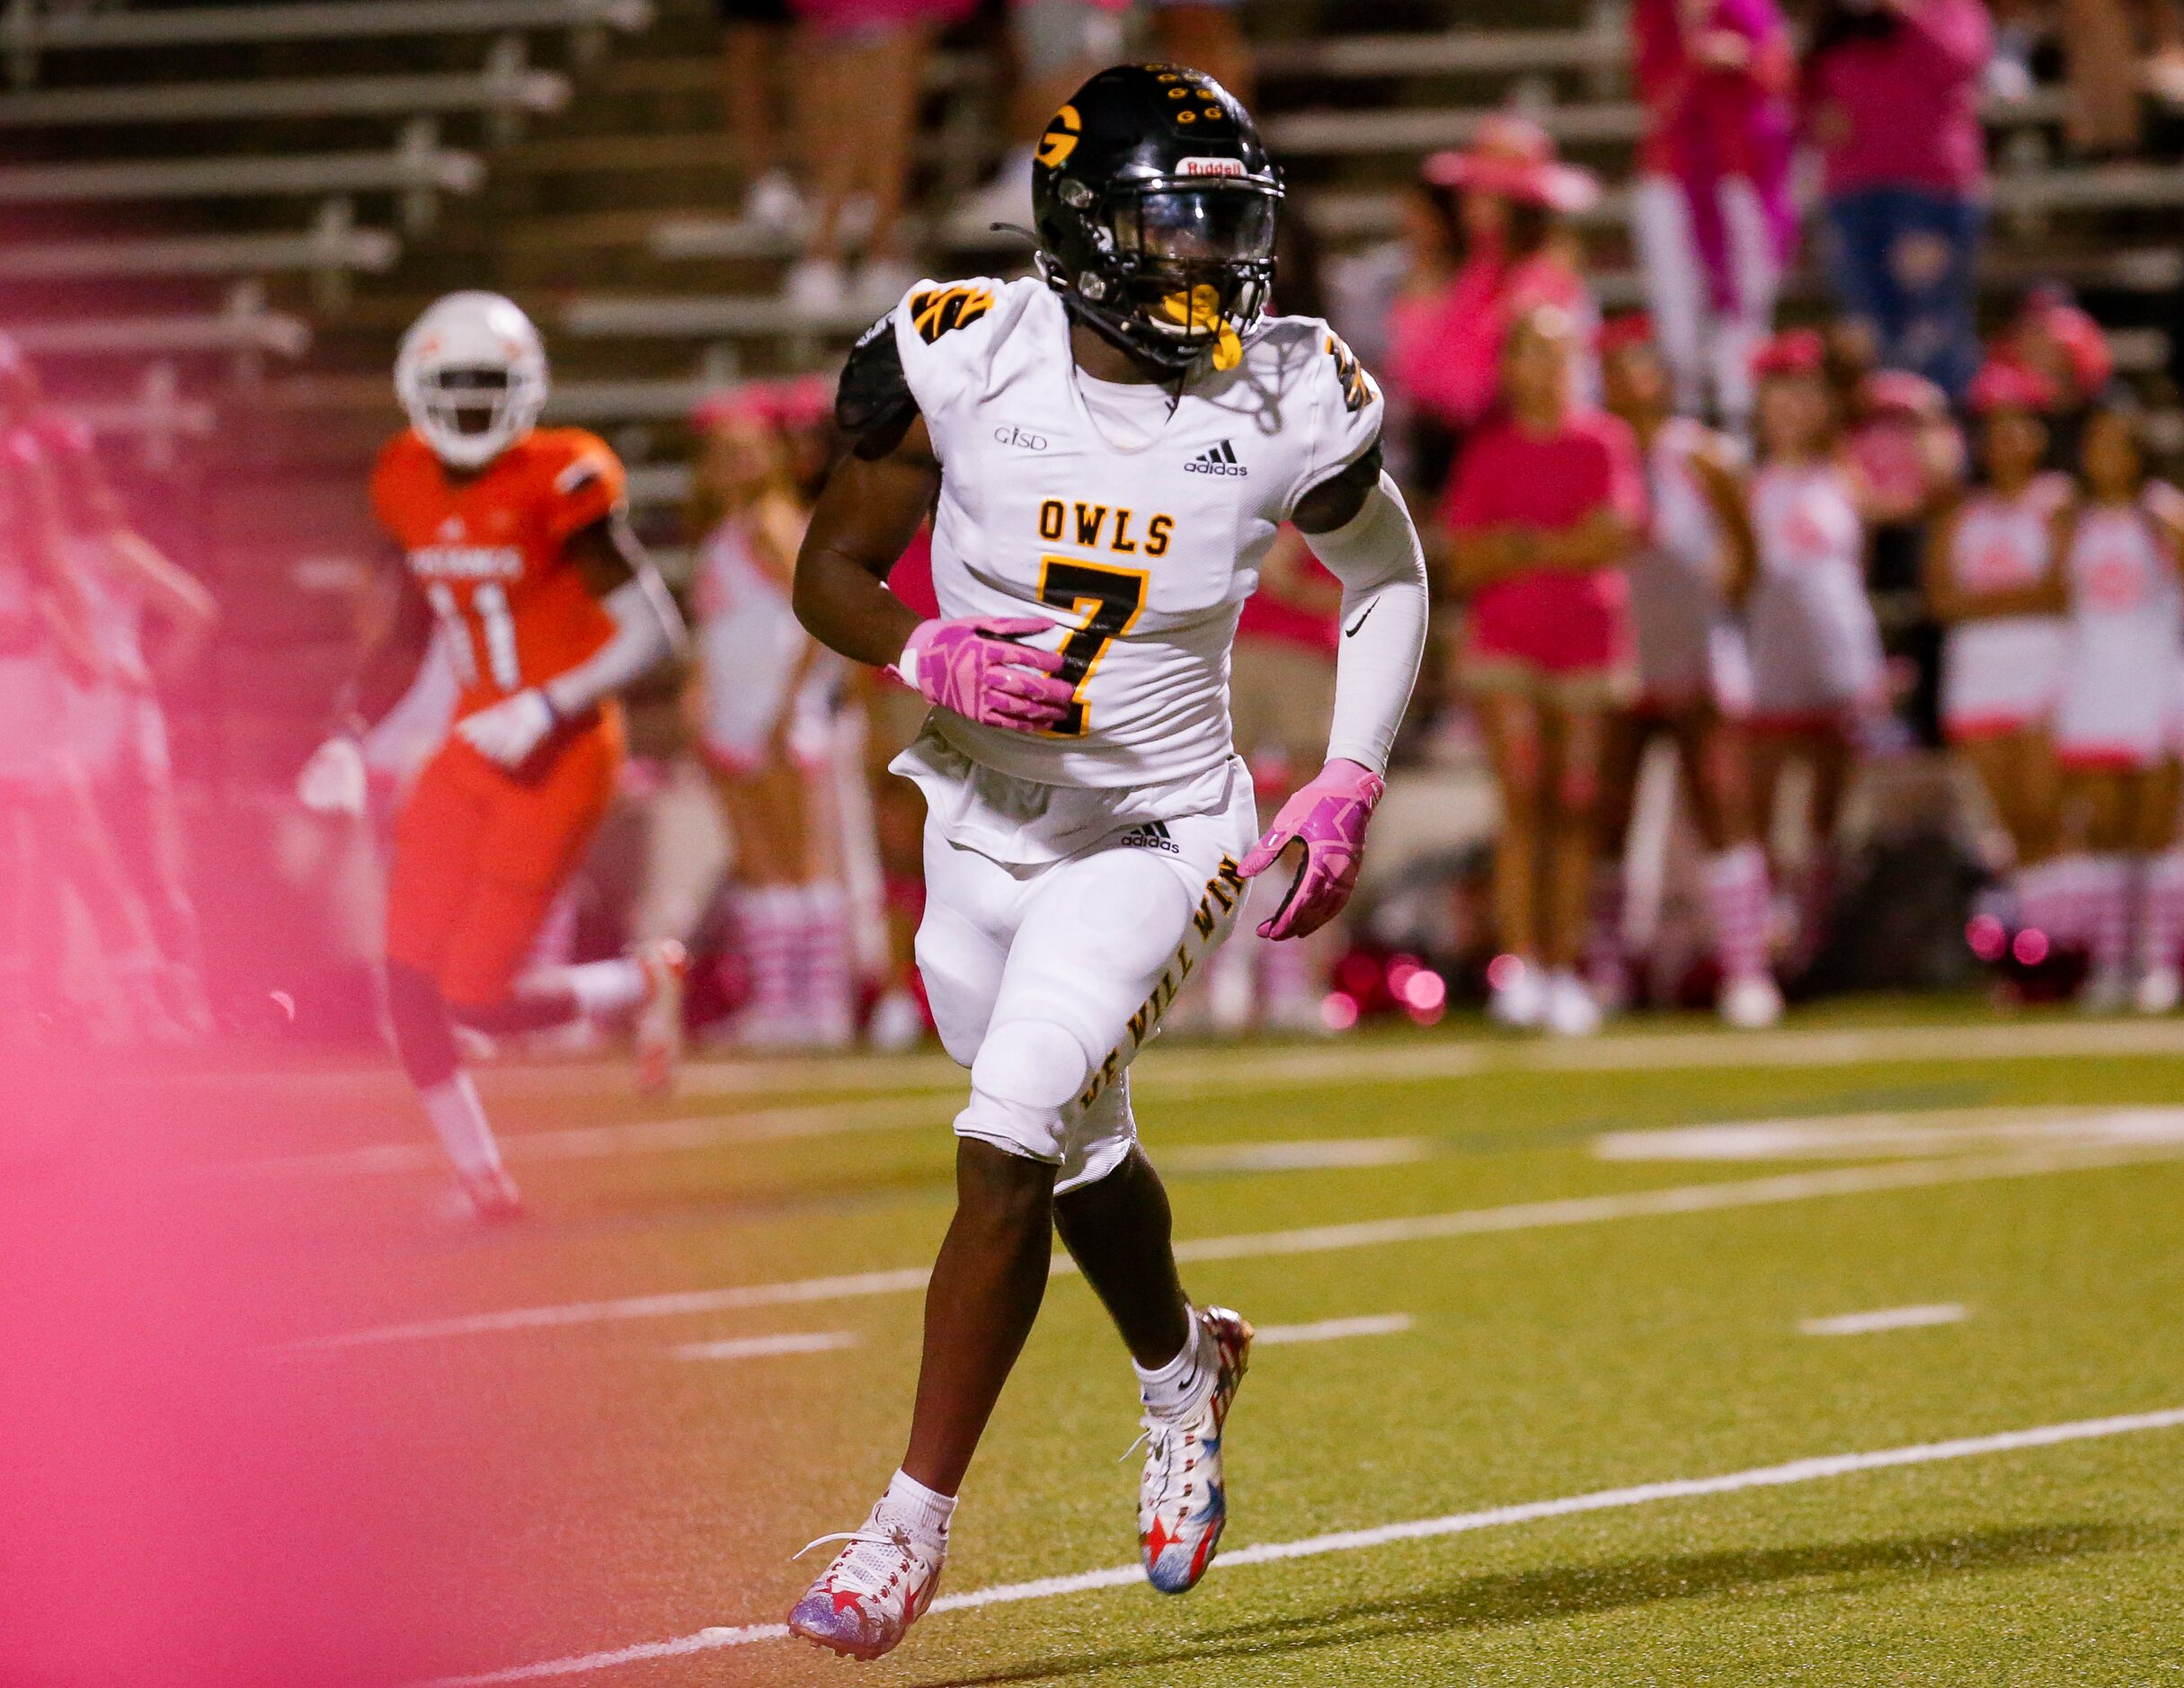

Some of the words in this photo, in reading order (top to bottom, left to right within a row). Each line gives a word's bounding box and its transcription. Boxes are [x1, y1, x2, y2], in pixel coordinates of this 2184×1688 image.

[1034, 103, 1082, 170] G
[1188, 162, 1240, 176] Riddell
[994, 426, 1048, 451] GISD
[1184, 459, 1247, 476] adidas
[1038, 496, 1176, 558] OWLS
[1036, 553, 1150, 740] 7
[1121, 833, 1180, 854] adidas
[1079, 1046, 1120, 1111] WE
[1126, 942, 1195, 1050] WILL
[1193, 851, 1247, 943] WIN
